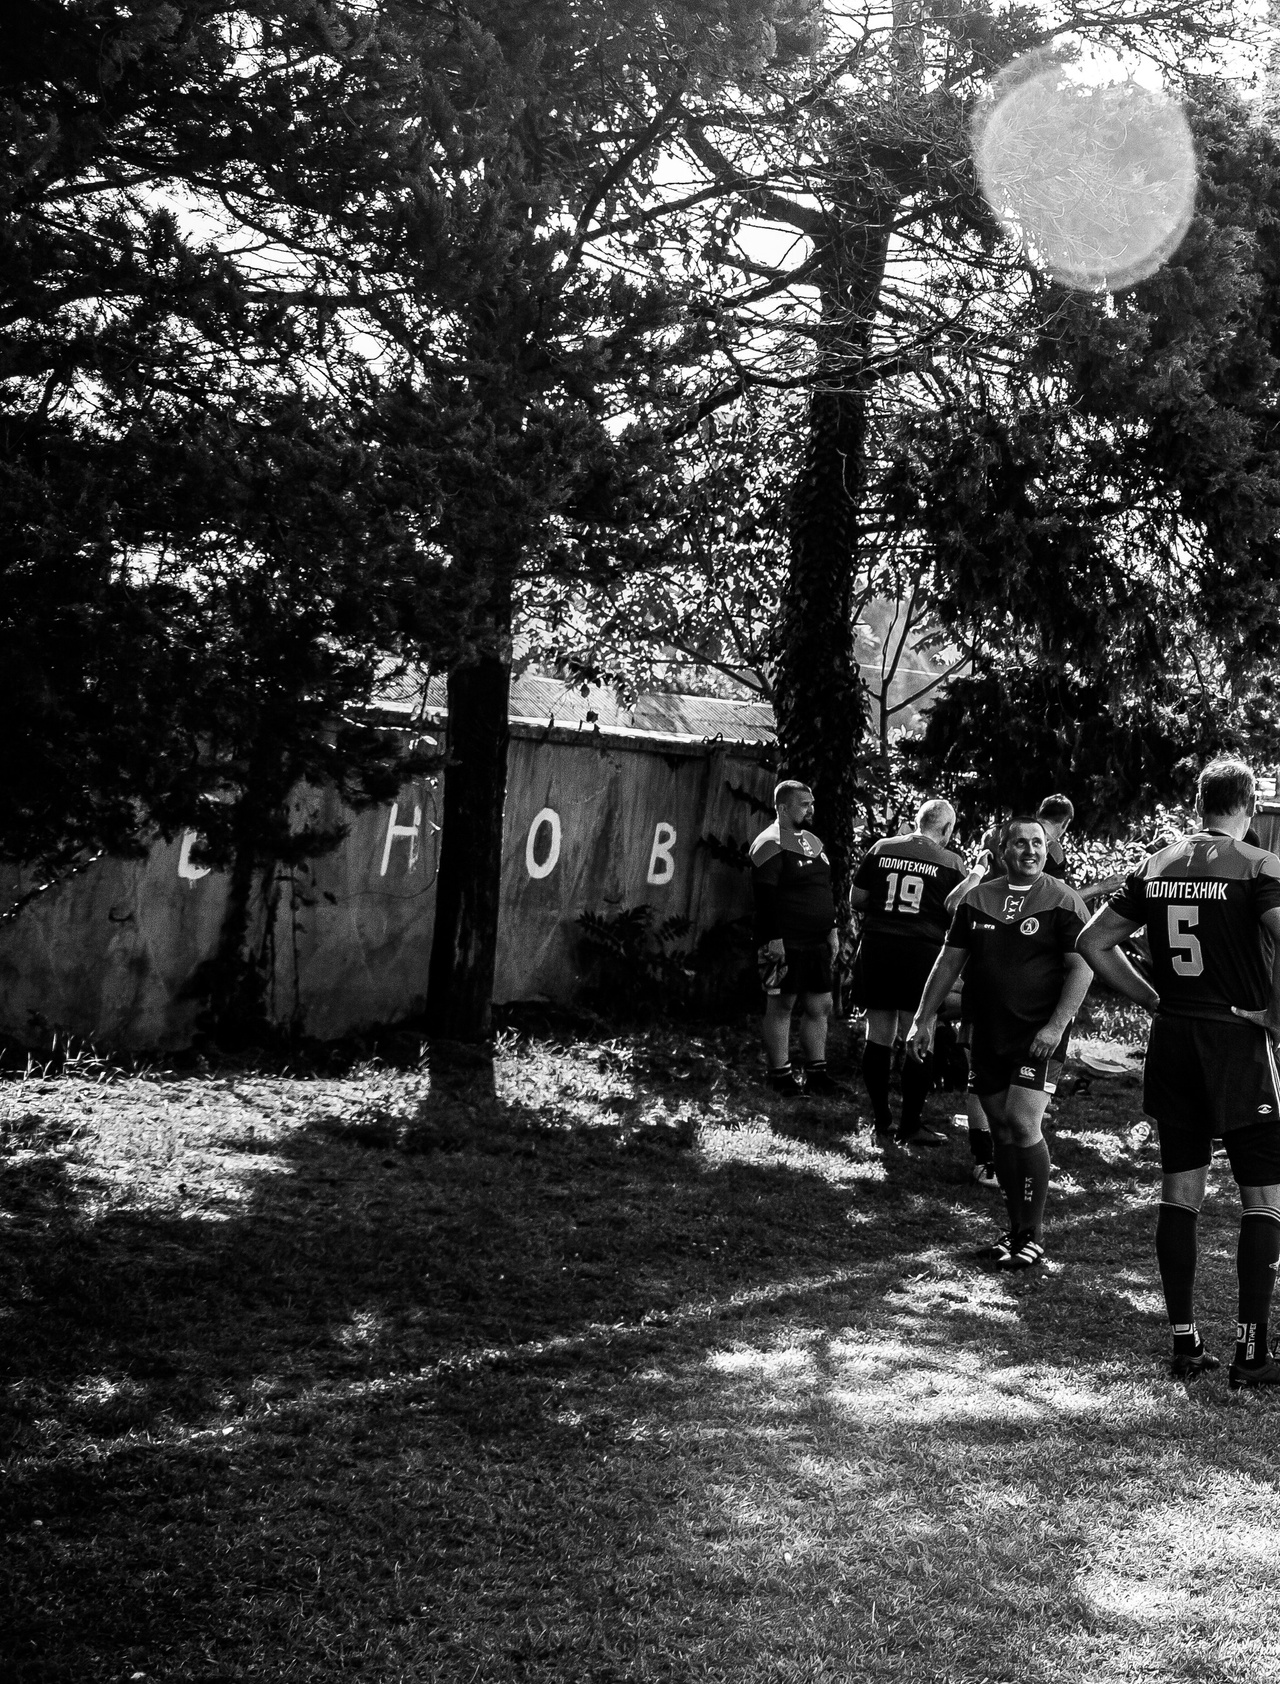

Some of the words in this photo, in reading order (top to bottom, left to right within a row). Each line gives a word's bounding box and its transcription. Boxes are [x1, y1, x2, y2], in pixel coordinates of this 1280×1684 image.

[878, 857, 939, 877] ПОЛИТЕХНИК
[884, 872, 924, 914] 19
[1145, 881, 1228, 900] ПОЛИТЕХНИК
[1167, 904, 1204, 977] 5
